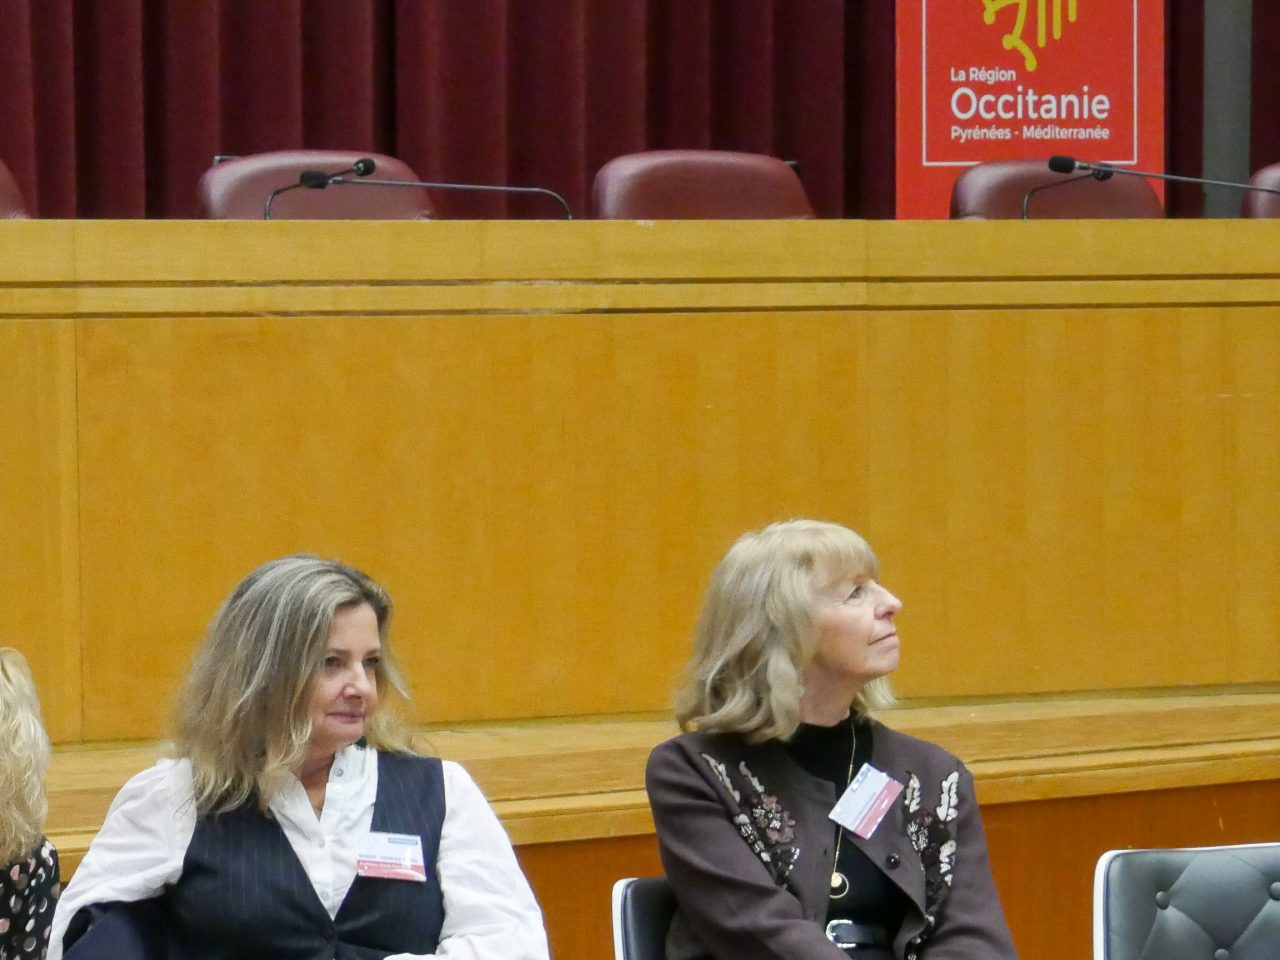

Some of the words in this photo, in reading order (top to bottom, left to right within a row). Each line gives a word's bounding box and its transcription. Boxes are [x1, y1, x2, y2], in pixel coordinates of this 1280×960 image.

[951, 67, 966, 82] La
[970, 67, 1016, 84] Région
[950, 85, 1110, 120] Occitanie
[951, 125, 1011, 143] Pyrénées
[1022, 124, 1110, 140] Méditerranée
